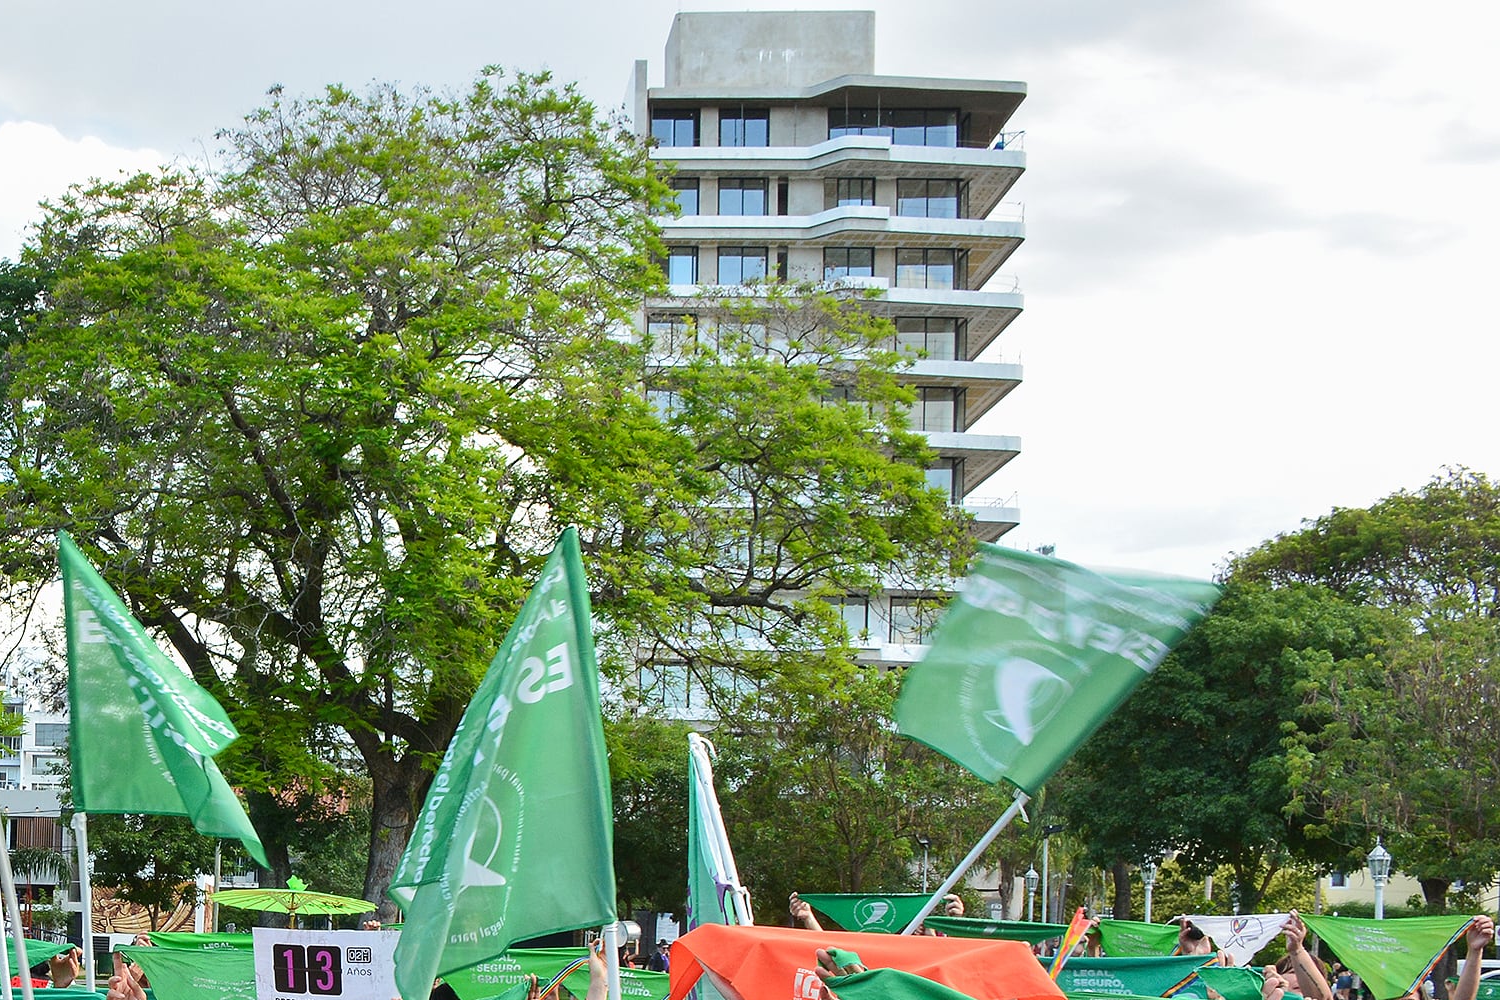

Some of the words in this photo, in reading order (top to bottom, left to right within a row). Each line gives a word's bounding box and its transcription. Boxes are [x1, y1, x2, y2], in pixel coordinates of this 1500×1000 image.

[435, 773, 450, 794] el
[413, 794, 444, 884] Derecho
[283, 949, 334, 991] 13
[347, 967, 372, 976] Años
[1073, 970, 1115, 978] LEGAL,
[1073, 979, 1125, 989] SEGURO,
